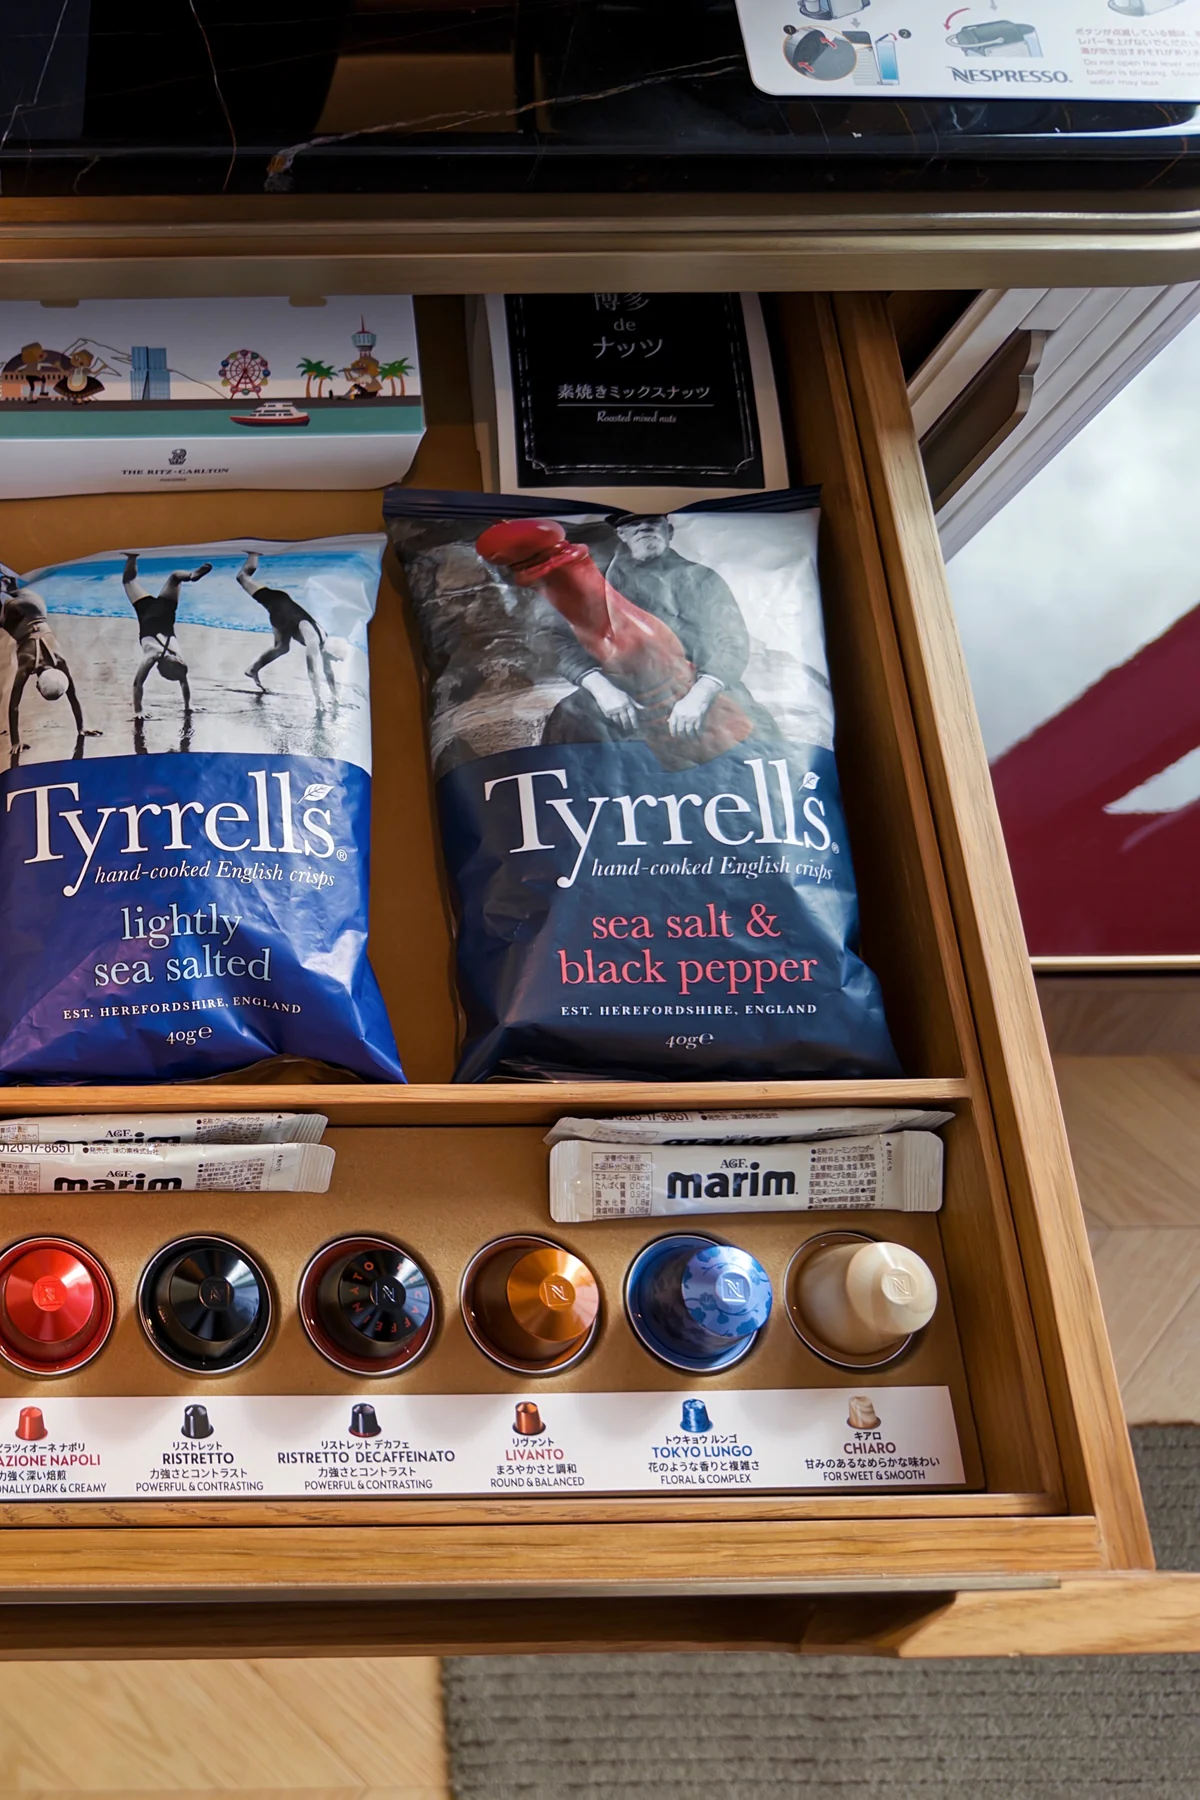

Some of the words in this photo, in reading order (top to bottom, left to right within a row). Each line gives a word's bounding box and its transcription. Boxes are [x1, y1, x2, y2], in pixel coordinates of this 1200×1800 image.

[613, 318, 636, 331] de
[593, 336, 663, 359] ナッツ
[557, 384, 710, 400] 素焼きミックスナッツ
[597, 410, 632, 423] Roasted
[633, 410, 658, 423] mixed
[659, 413, 677, 423] nuts
[95, 861, 210, 884] hand-cooked
[215, 861, 284, 884] English
[289, 869, 335, 888] crisps
[591, 856, 713, 877] hand-cooked
[720, 856, 791, 880] English
[795, 860, 833, 884] crisps
[121, 903, 242, 949] lightly
[592, 914, 653, 940] sea
[667, 903, 734, 940] salt
[746, 903, 781, 938] &
[94, 958, 154, 987] sea
[166, 945, 271, 982] salted
[557, 949, 667, 986] black
[678, 957, 818, 995] pepper
[63, 1008, 94, 1020] EST.
[100, 997, 229, 1018] HEREFORDSHIRE,
[233, 996, 302, 1015] ENGLAND
[561, 1006, 593, 1017] EST.
[599, 1005, 738, 1017] HEREFORDSHIRE,
[745, 1004, 817, 1015] ENGLAND
[54, 1173, 182, 1191] marim
[667, 1162, 796, 1199] marim
[511, 1437, 554, 1447] リヴァント
[665, 1435, 707, 1444] トウキョウ
[711, 1434, 737, 1443] ルンゴ
[854, 1431, 882, 1441] キアロ
[59, 1442, 85, 1452] ナポリ
[172, 1441, 222, 1450] リストレット
[321, 1440, 371, 1449] リストレット
[374, 1440, 409, 1449] デカフェ
[843, 1442, 896, 1454] CHIARO
[277, 1451, 349, 1464] RISTRETTO
[355, 1450, 455, 1463] DECAFFEINATO
[505, 1448, 564, 1461] LIVANTO
[652, 1446, 701, 1458] TOKYO
[704, 1445, 752, 1457] LUNGO
[50, 1453, 101, 1466] NAPOLI
[162, 1452, 234, 1465] RISTRETTO
[804, 1457, 940, 1469] 甘みのあるなめらかな味わい
[318, 1466, 416, 1478] 力強さとコントラスト
[496, 1463, 577, 1475] まろやかさと調和
[648, 1460, 760, 1472] 花のような香りと複雑さ
[150, 1468, 247, 1479] 力強さとコントラスト
[661, 1474, 698, 1485] FLORAL
[699, 1473, 706, 1484] &
[707, 1473, 752, 1484] COMPLEX
[823, 1471, 843, 1481] FOR
[843, 1470, 874, 1481] SWEET
[875, 1470, 883, 1480] &
[883, 1469, 926, 1480] SMOOTH
[32, 1483, 58, 1494] DARK
[60, 1483, 67, 1493] &
[68, 1482, 107, 1493] CREAMY
[136, 1481, 187, 1492] POWERFUL
[189, 1481, 196, 1492] &
[197, 1480, 264, 1491] CONTRASTING
[304, 1480, 355, 1490] POWERFUL
[357, 1479, 365, 1490] &
[366, 1479, 433, 1490] CONTRASTING
[490, 1477, 525, 1488] ROUND
[526, 1477, 533, 1487] &
[535, 1476, 585, 1487] BALANCED
